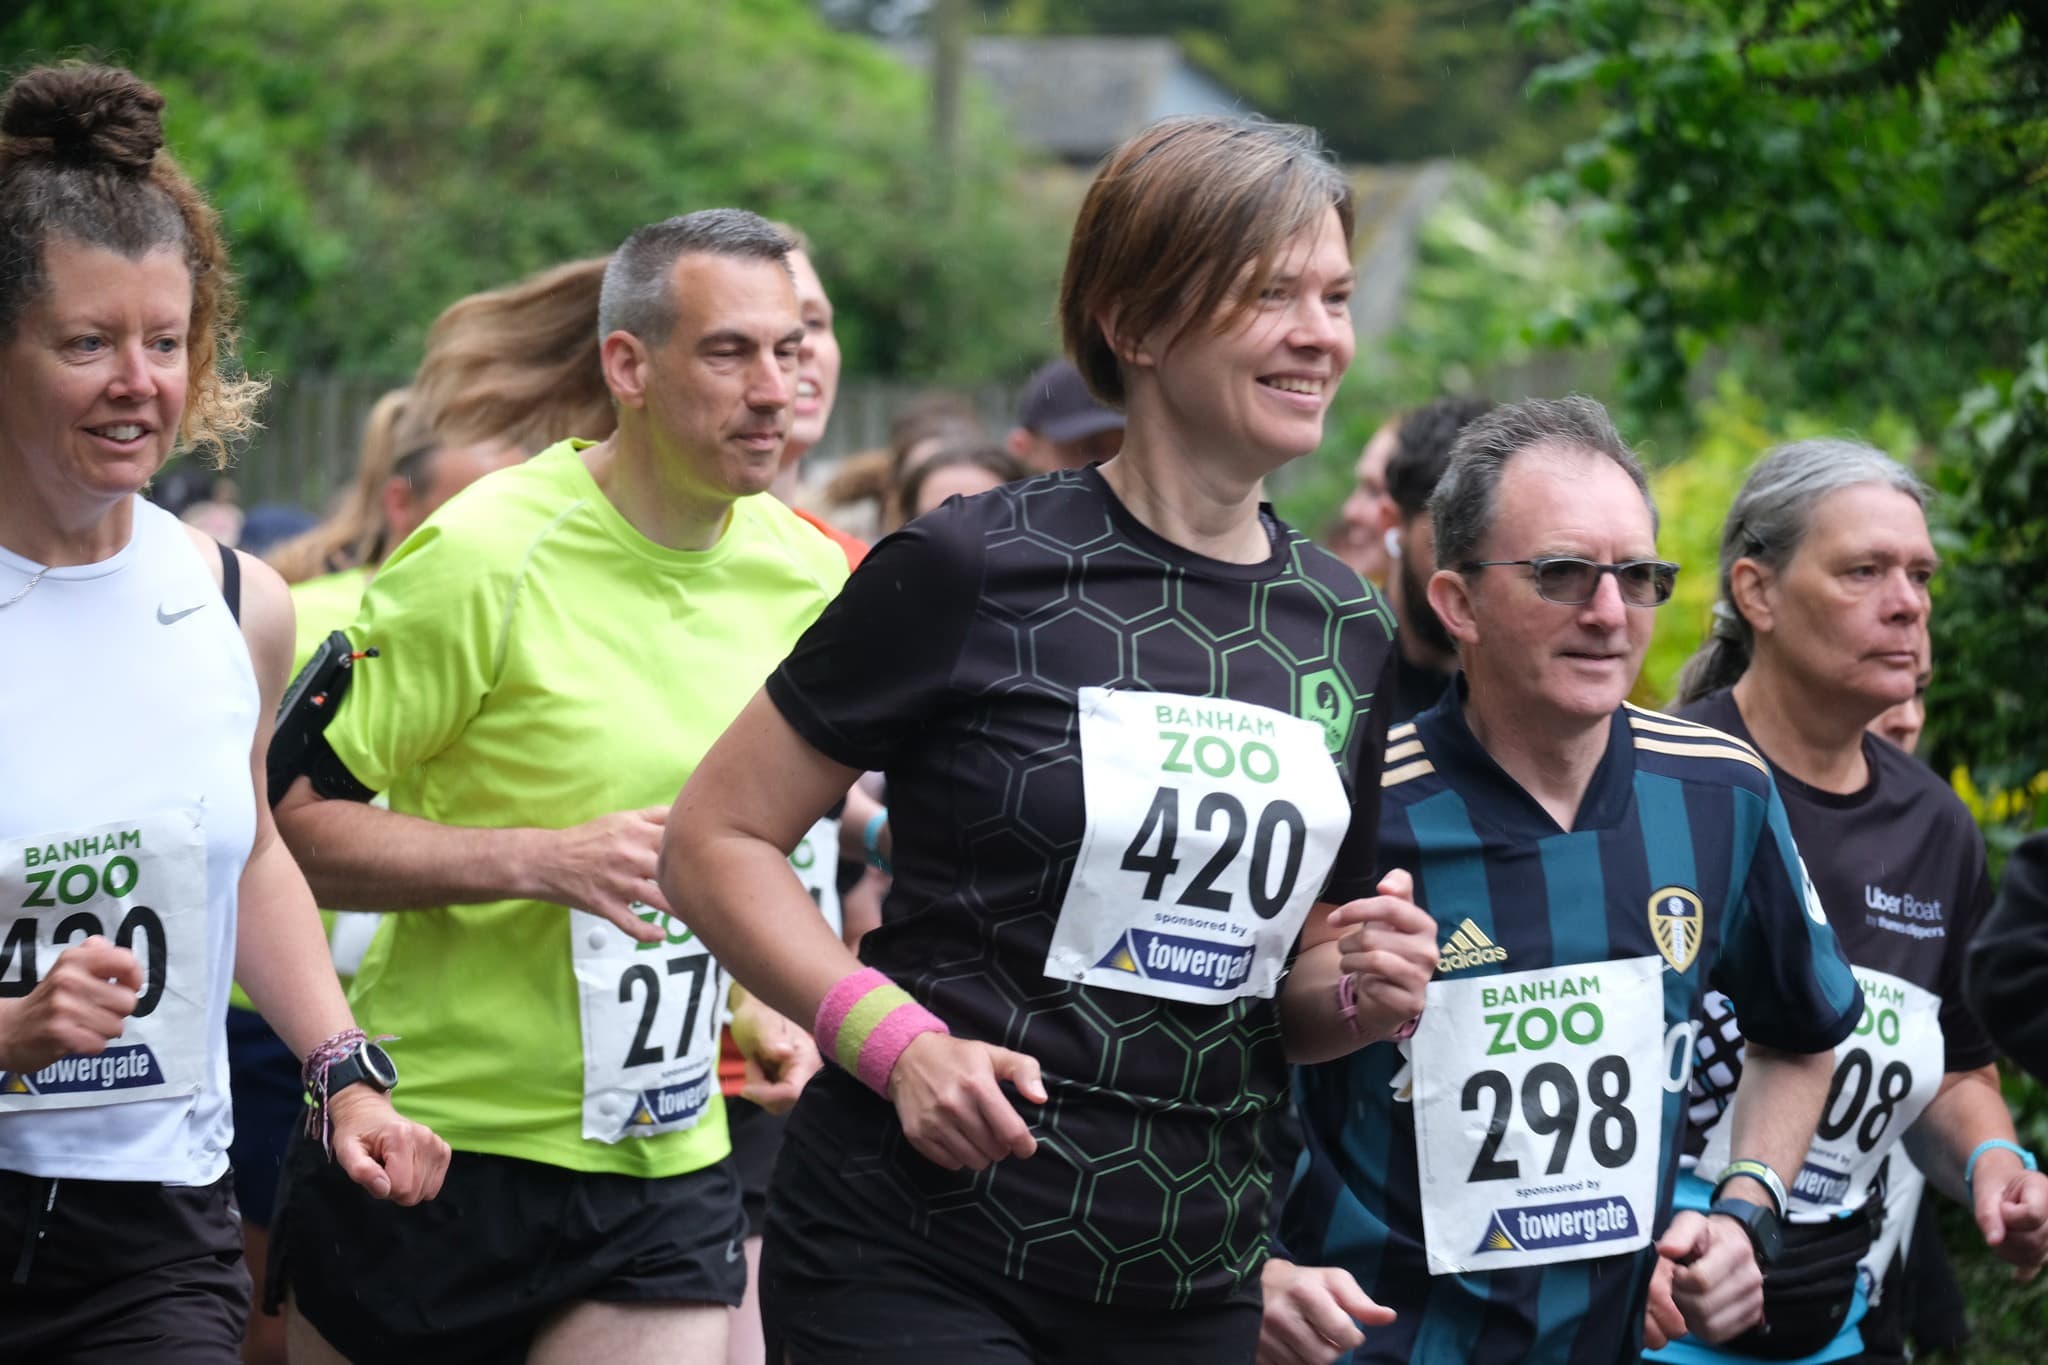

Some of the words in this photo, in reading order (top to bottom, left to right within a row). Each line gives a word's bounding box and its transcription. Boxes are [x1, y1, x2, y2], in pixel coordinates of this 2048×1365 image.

[1154, 704, 1276, 737] BANHAM
[1158, 731, 1280, 784] ZOO
[24, 829, 142, 868] BANHAM
[1120, 786, 1307, 920] 420
[22, 855, 139, 908] ZOO
[1865, 884, 1901, 915] Uber
[1904, 893, 1943, 920] Boat
[1154, 912, 1228, 932] sponsored
[1230, 923, 1248, 937] by
[1437, 946, 1508, 973] adidas
[619, 953, 720, 1069] 27
[1482, 976, 1600, 1008] BANHAM
[1483, 1003, 1604, 1056] ZOO
[1461, 1055, 1638, 1184] 298
[1517, 1200, 1629, 1241] towergate
